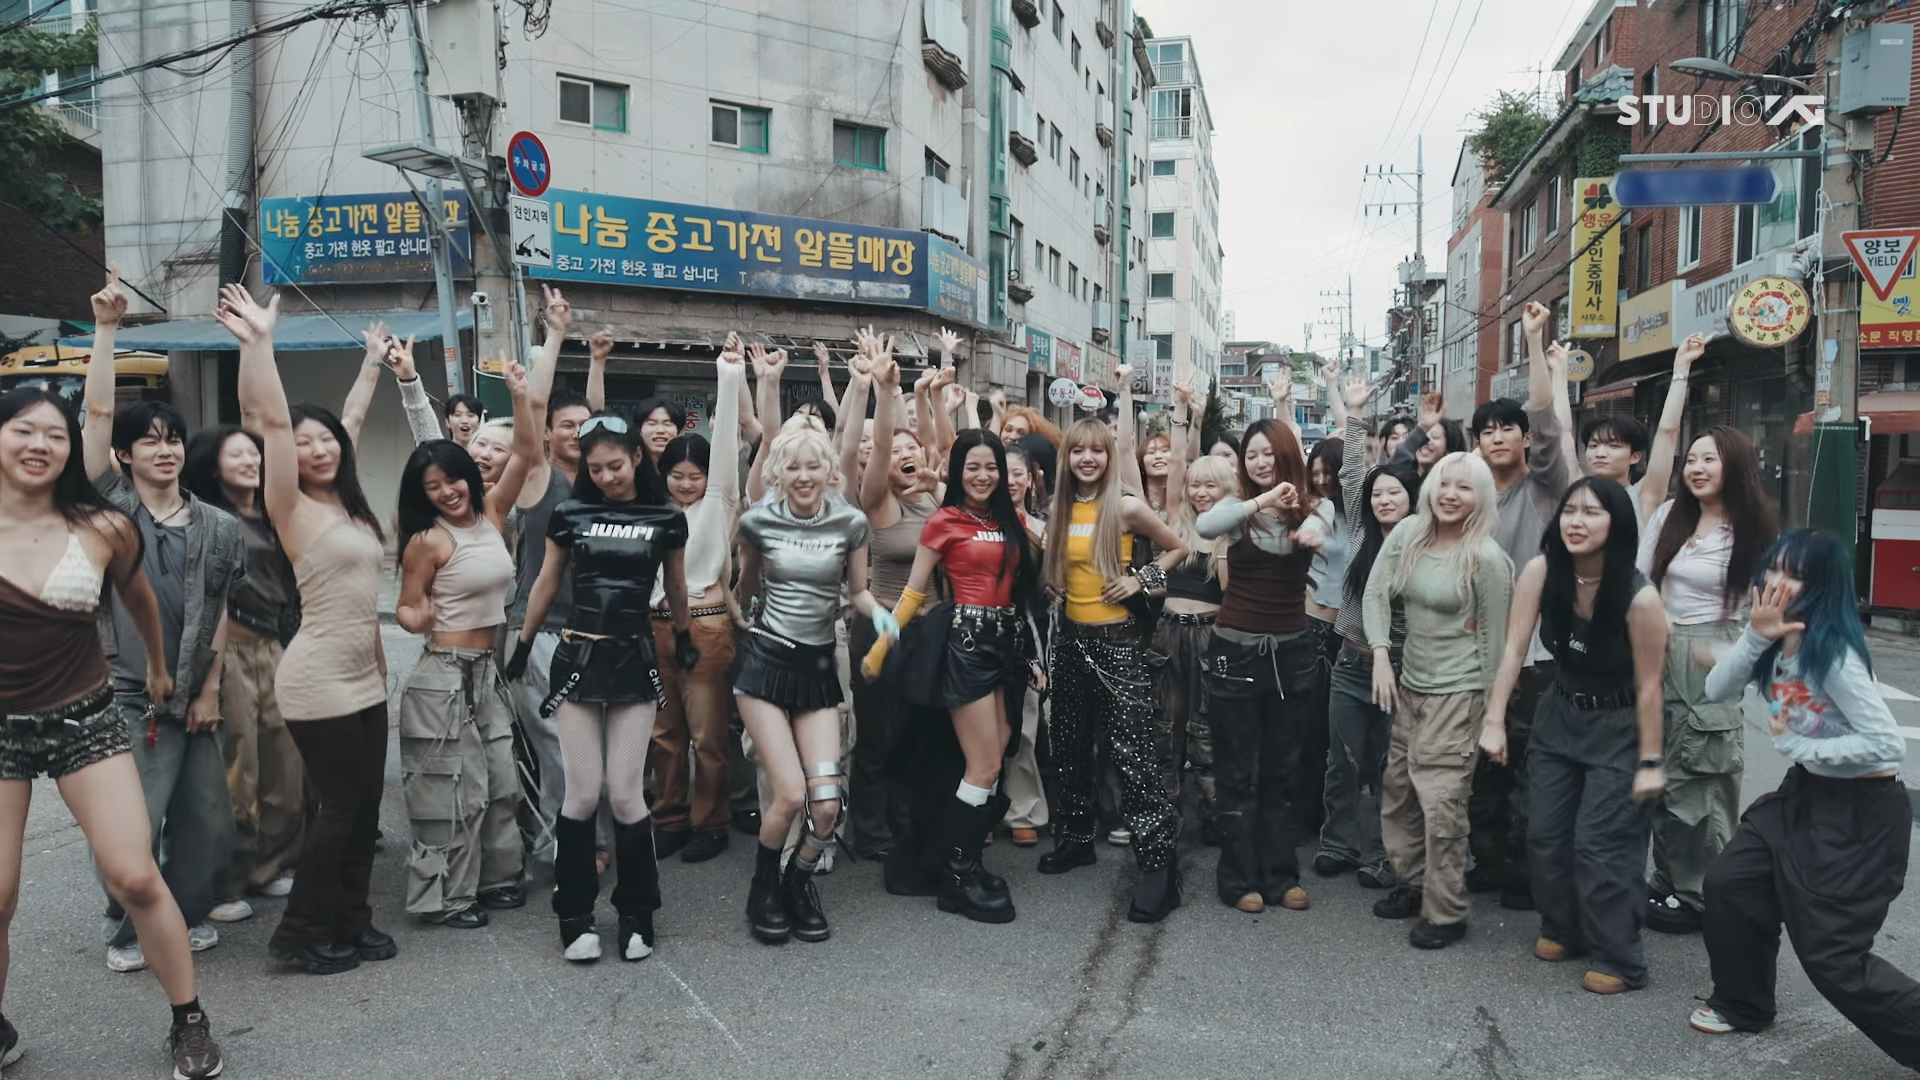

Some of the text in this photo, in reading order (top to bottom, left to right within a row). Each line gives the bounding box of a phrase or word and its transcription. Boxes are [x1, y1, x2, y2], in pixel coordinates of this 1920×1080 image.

[266, 200, 461, 239] 나눔 중고가전 알뜰장
[514, 205, 548, 225] 견인지역
[1582, 212, 1613, 228] 행운
[304, 237, 430, 260] 중고 가전 헌옷 팔고 삽니다
[555, 202, 916, 276] 나눔 중고가전 알뜰매장
[1864, 239, 1901, 255] 양보
[556, 255, 719, 283] 중고 가전 헌옷 팔고 삽니다
[1585, 231, 1605, 312] 공인중개사
[1867, 256, 1898, 267] YIELD
[1892, 295, 1911, 316] 옛
[1580, 314, 1605, 322] 사무소
[1049, 388, 1076, 399] 부동산
[545, 672, 580, 712] CHANEL
